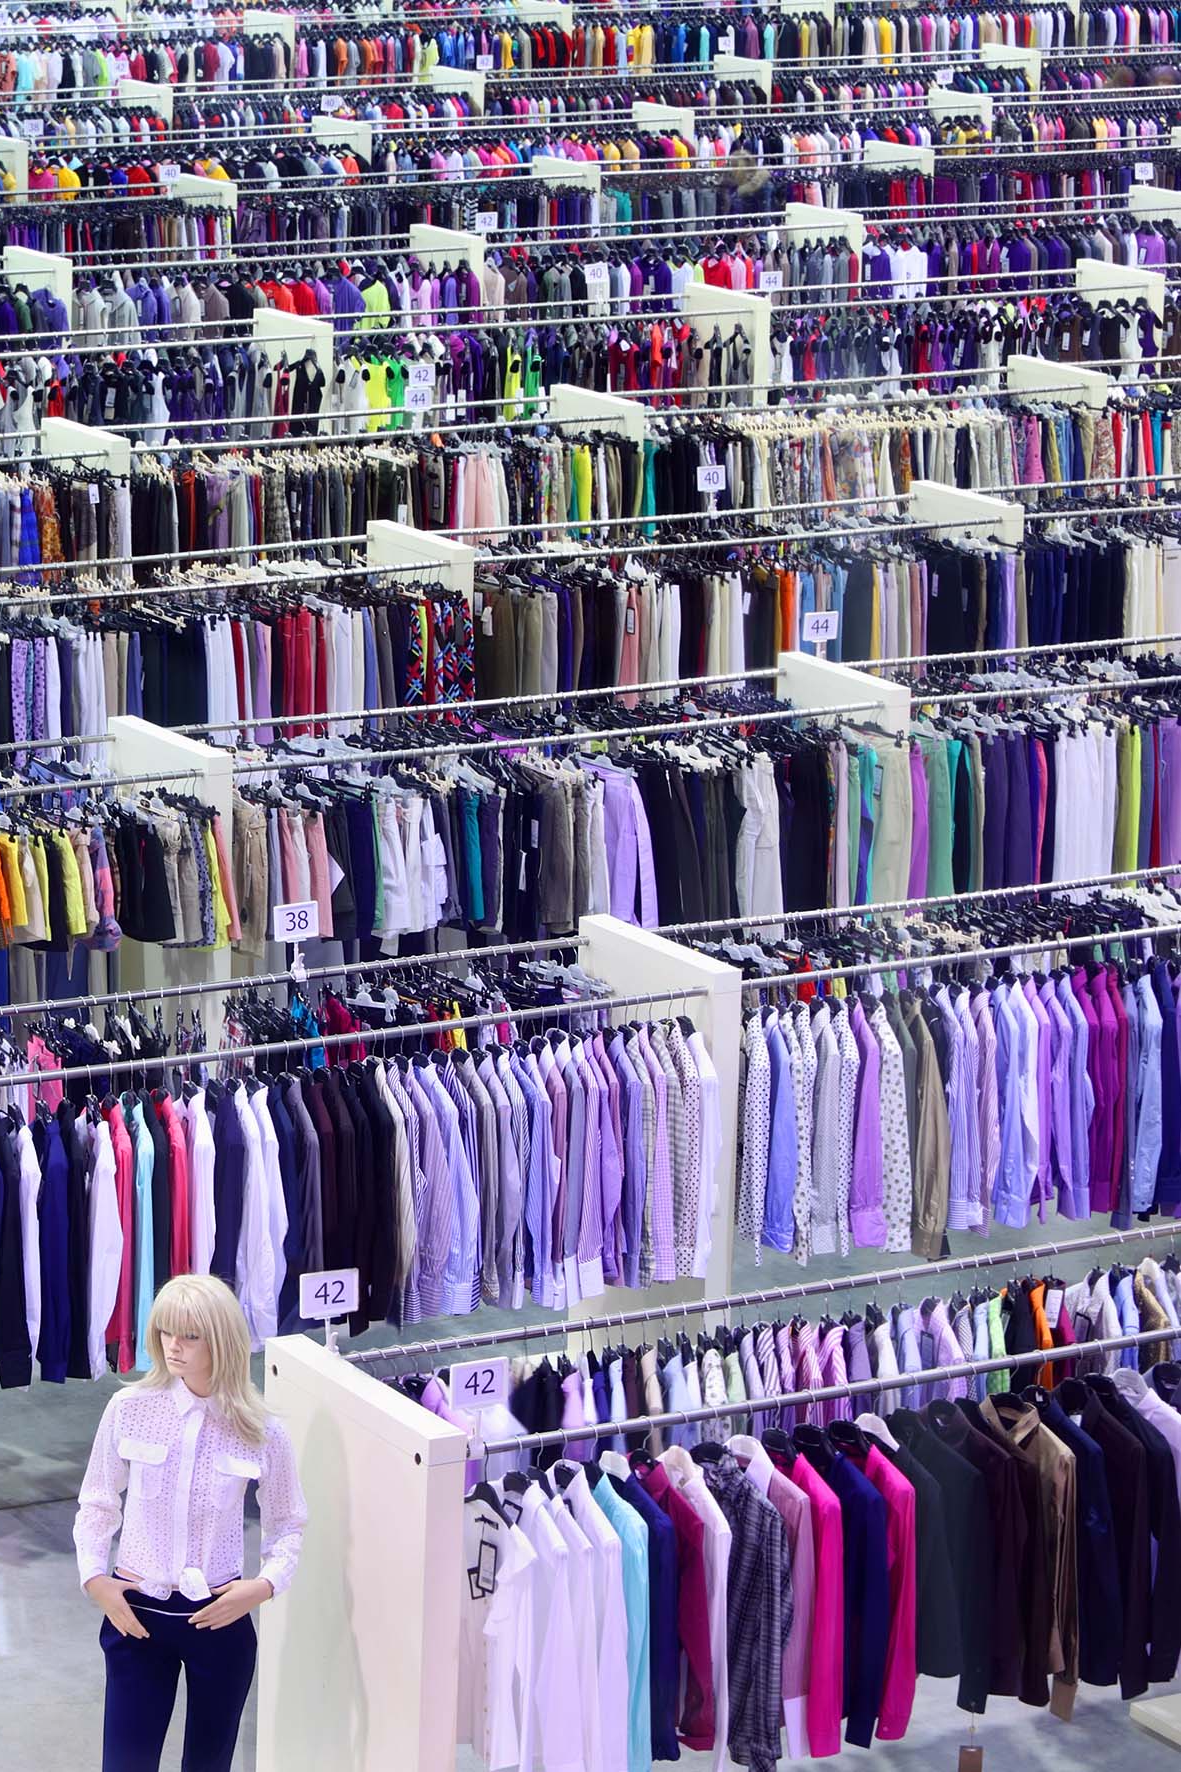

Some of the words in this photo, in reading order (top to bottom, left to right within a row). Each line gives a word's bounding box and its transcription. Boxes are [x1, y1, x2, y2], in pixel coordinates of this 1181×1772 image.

[164, 168, 177, 178] 40
[480, 217, 493, 226] 42
[588, 267, 602, 278] 40
[765, 276, 777, 285] 44
[414, 369, 429, 381] 42
[411, 393, 425, 406] 44
[704, 471, 719, 484] 40
[810, 619, 829, 634] 44
[285, 910, 308, 931] 38
[314, 1280, 346, 1305] 42
[465, 1369, 495, 1396] 42
